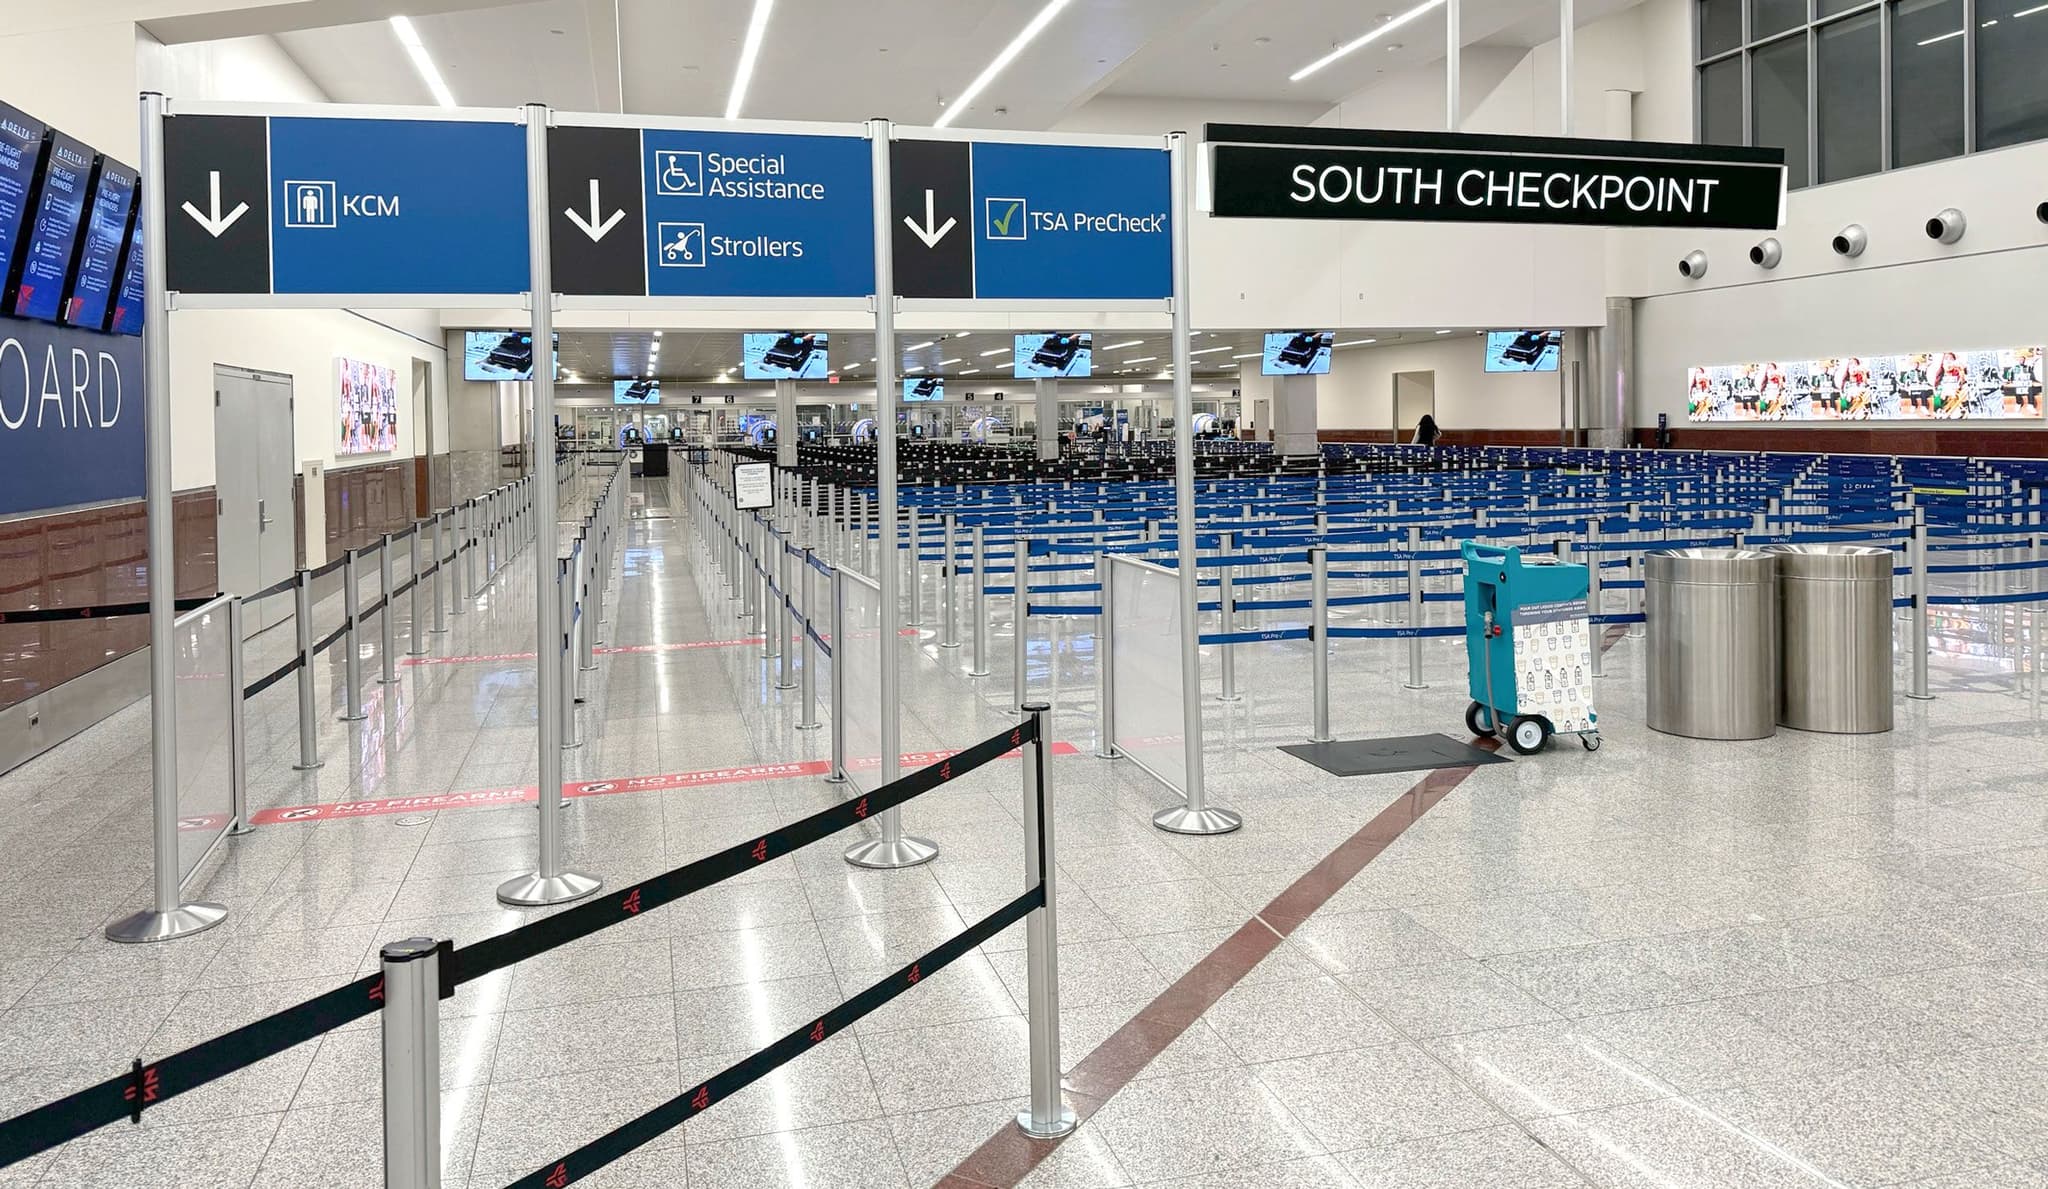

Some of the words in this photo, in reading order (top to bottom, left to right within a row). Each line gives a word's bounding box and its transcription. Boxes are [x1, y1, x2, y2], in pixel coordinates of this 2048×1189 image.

[8, 121, 30, 140] DELTA
[63, 149, 82, 165] DELTA
[708, 152, 785, 176] Special
[110, 172, 127, 185] DELTA
[708, 178, 825, 200] Assistance
[1290, 164, 1443, 205] SOUTH
[1456, 169, 1720, 213] CHECKPOINT
[343, 195, 400, 216] KCM
[1030, 212, 1069, 231] TSA
[710, 236, 804, 258] Strollers
[676, 764, 800, 781] FIREARMS
[335, 803, 377, 811] NO
[386, 790, 526, 807] FIREARMS
